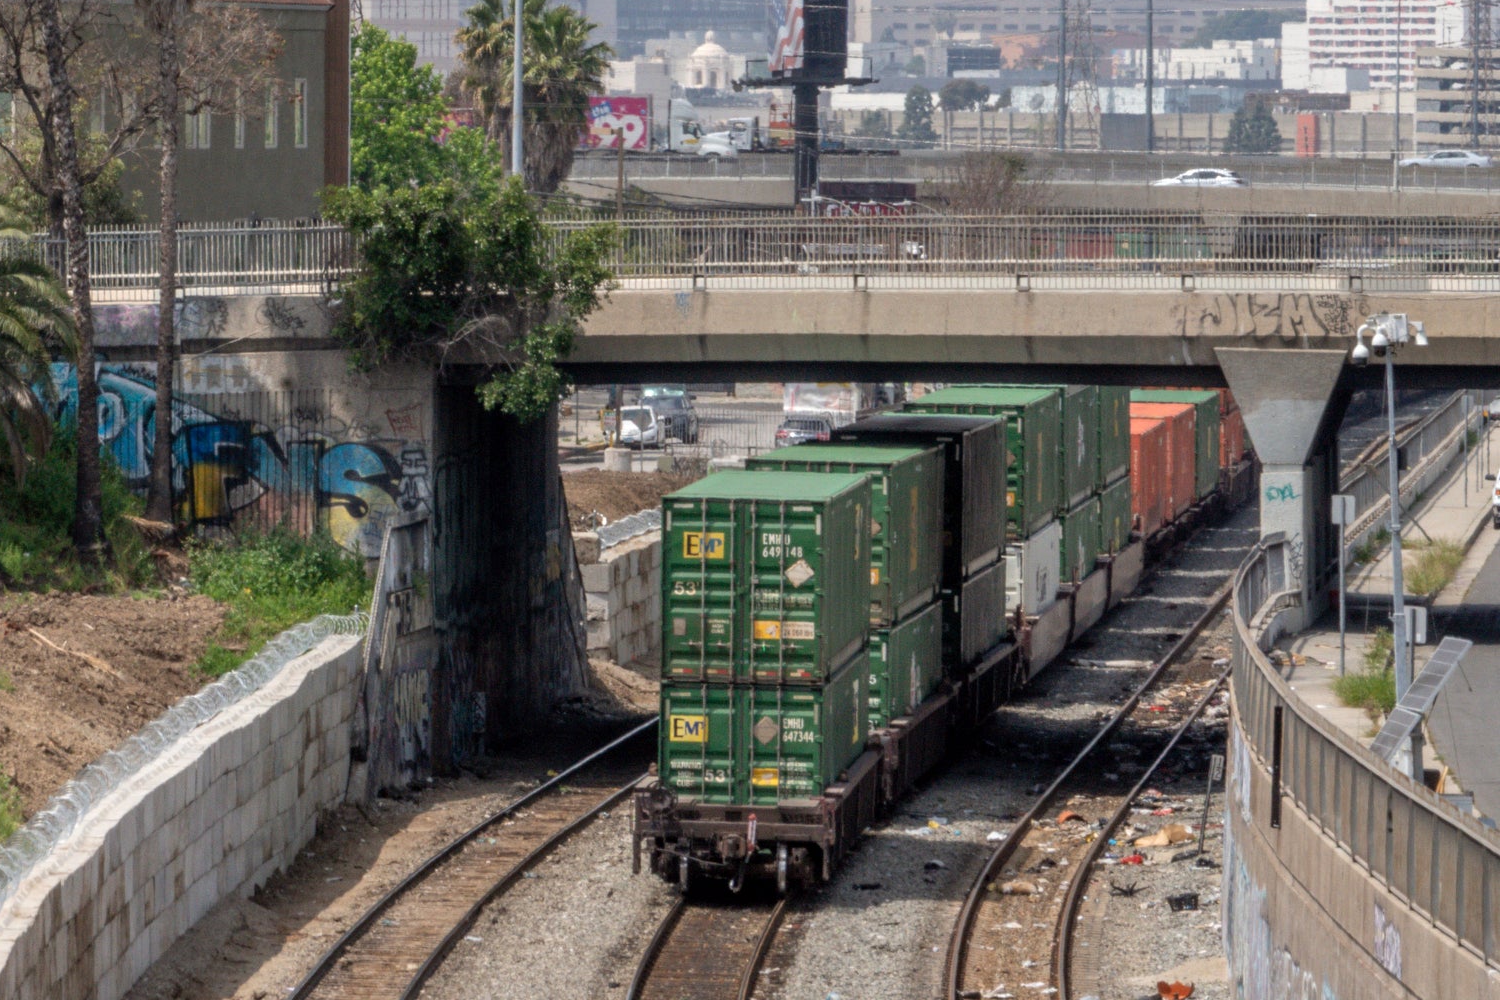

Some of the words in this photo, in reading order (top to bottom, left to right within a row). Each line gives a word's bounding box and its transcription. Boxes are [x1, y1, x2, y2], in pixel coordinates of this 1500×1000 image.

[763, 533, 790, 545] EMHU
[783, 718, 804, 729] EMHU
[783, 731, 814, 743] 647344
